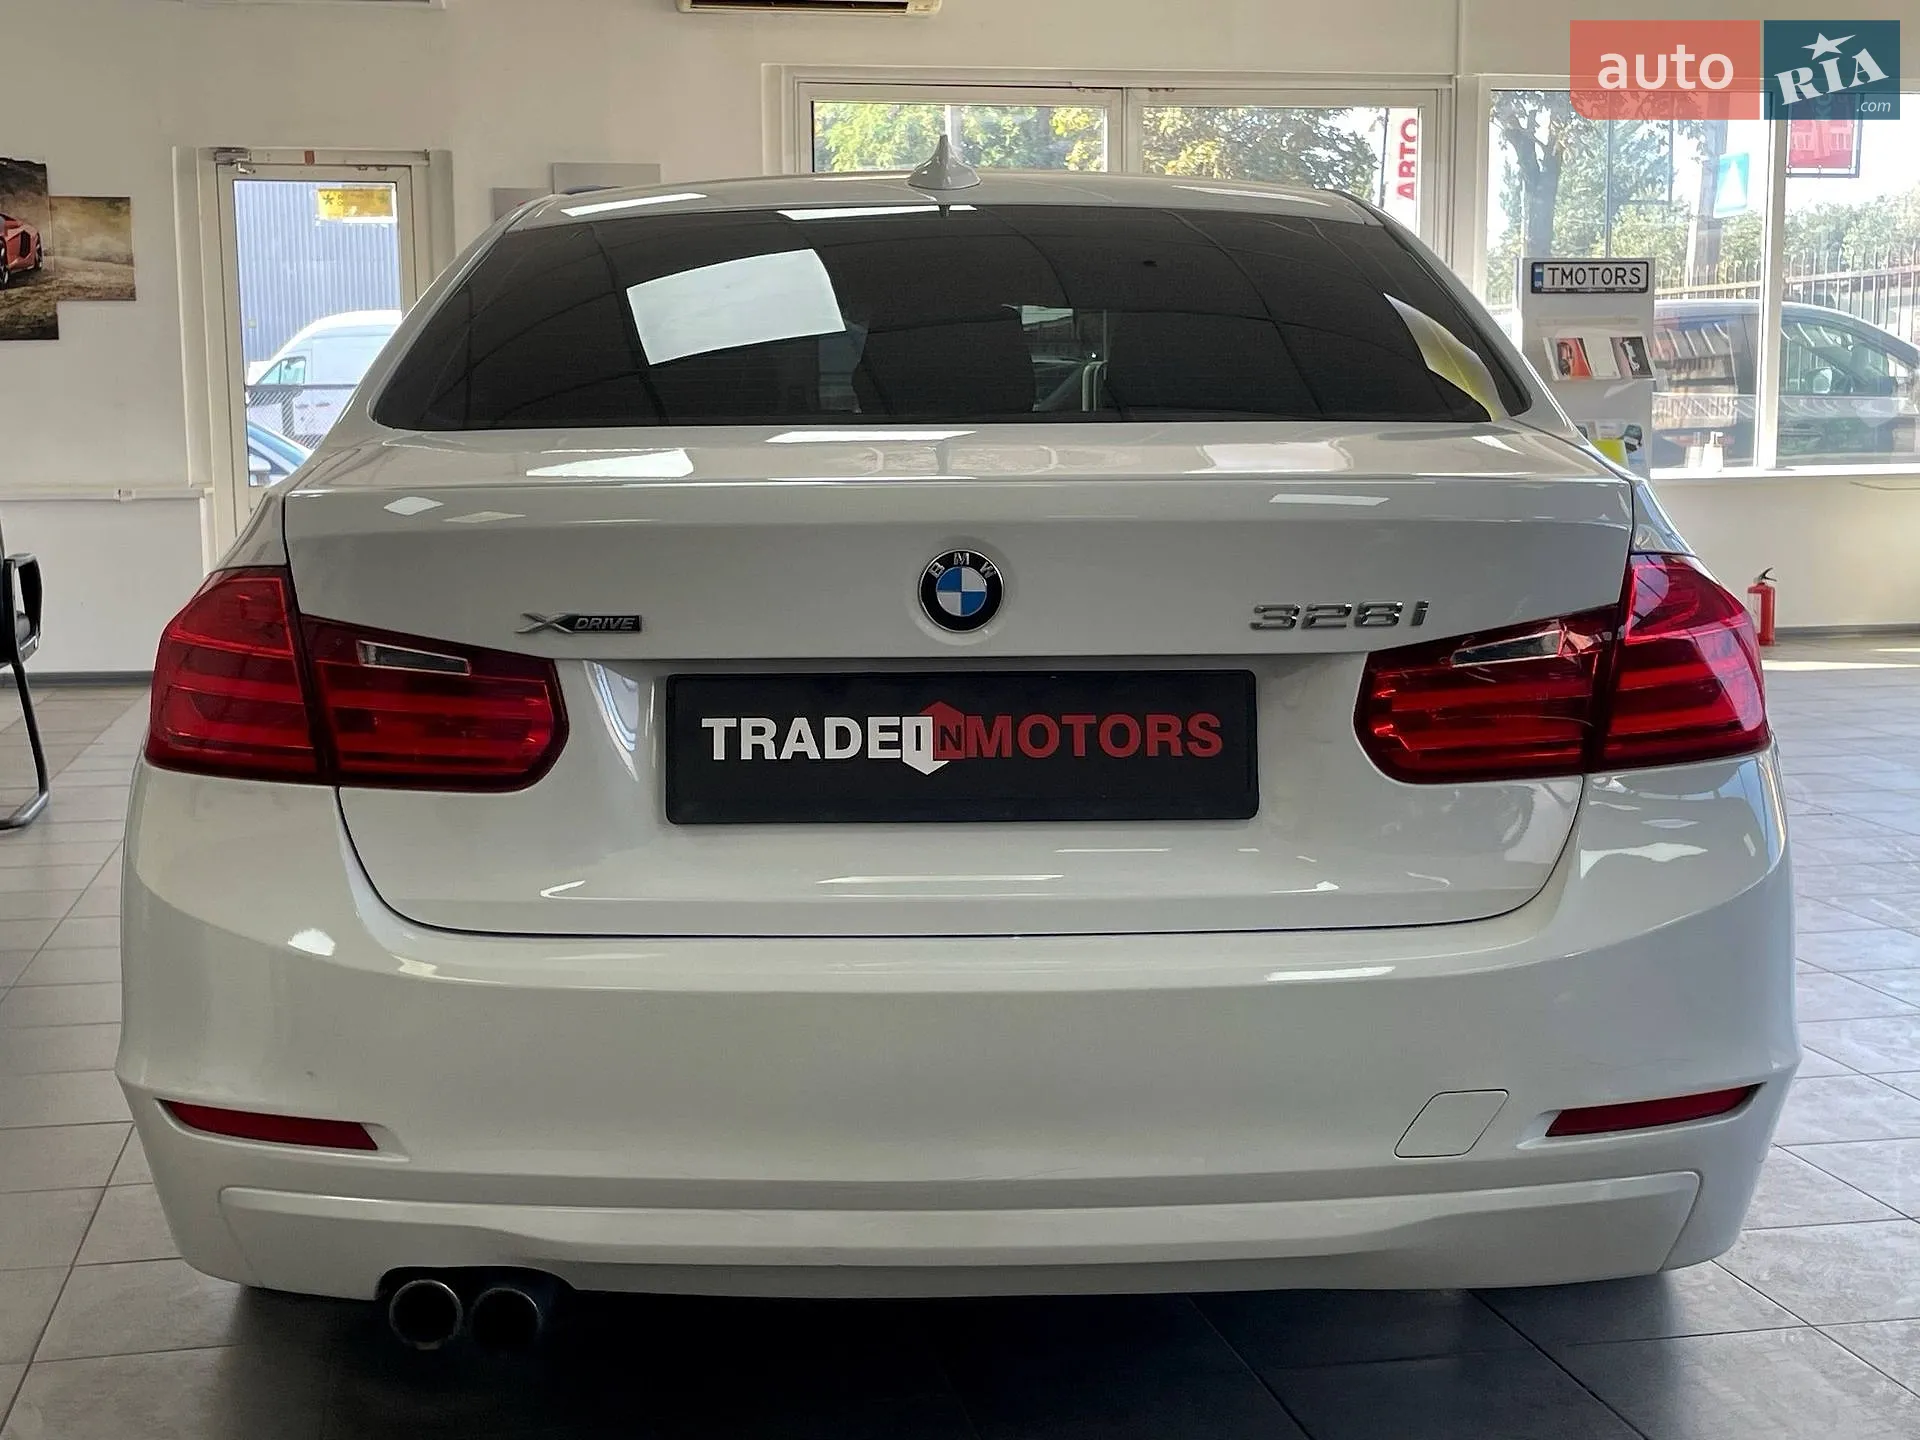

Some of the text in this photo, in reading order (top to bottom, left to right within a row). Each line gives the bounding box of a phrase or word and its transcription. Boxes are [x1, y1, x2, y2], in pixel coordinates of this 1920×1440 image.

[1547, 267, 1641, 286] TMOTORS
[928, 552, 996, 579] BMW
[1250, 600, 1429, 630] 328i
